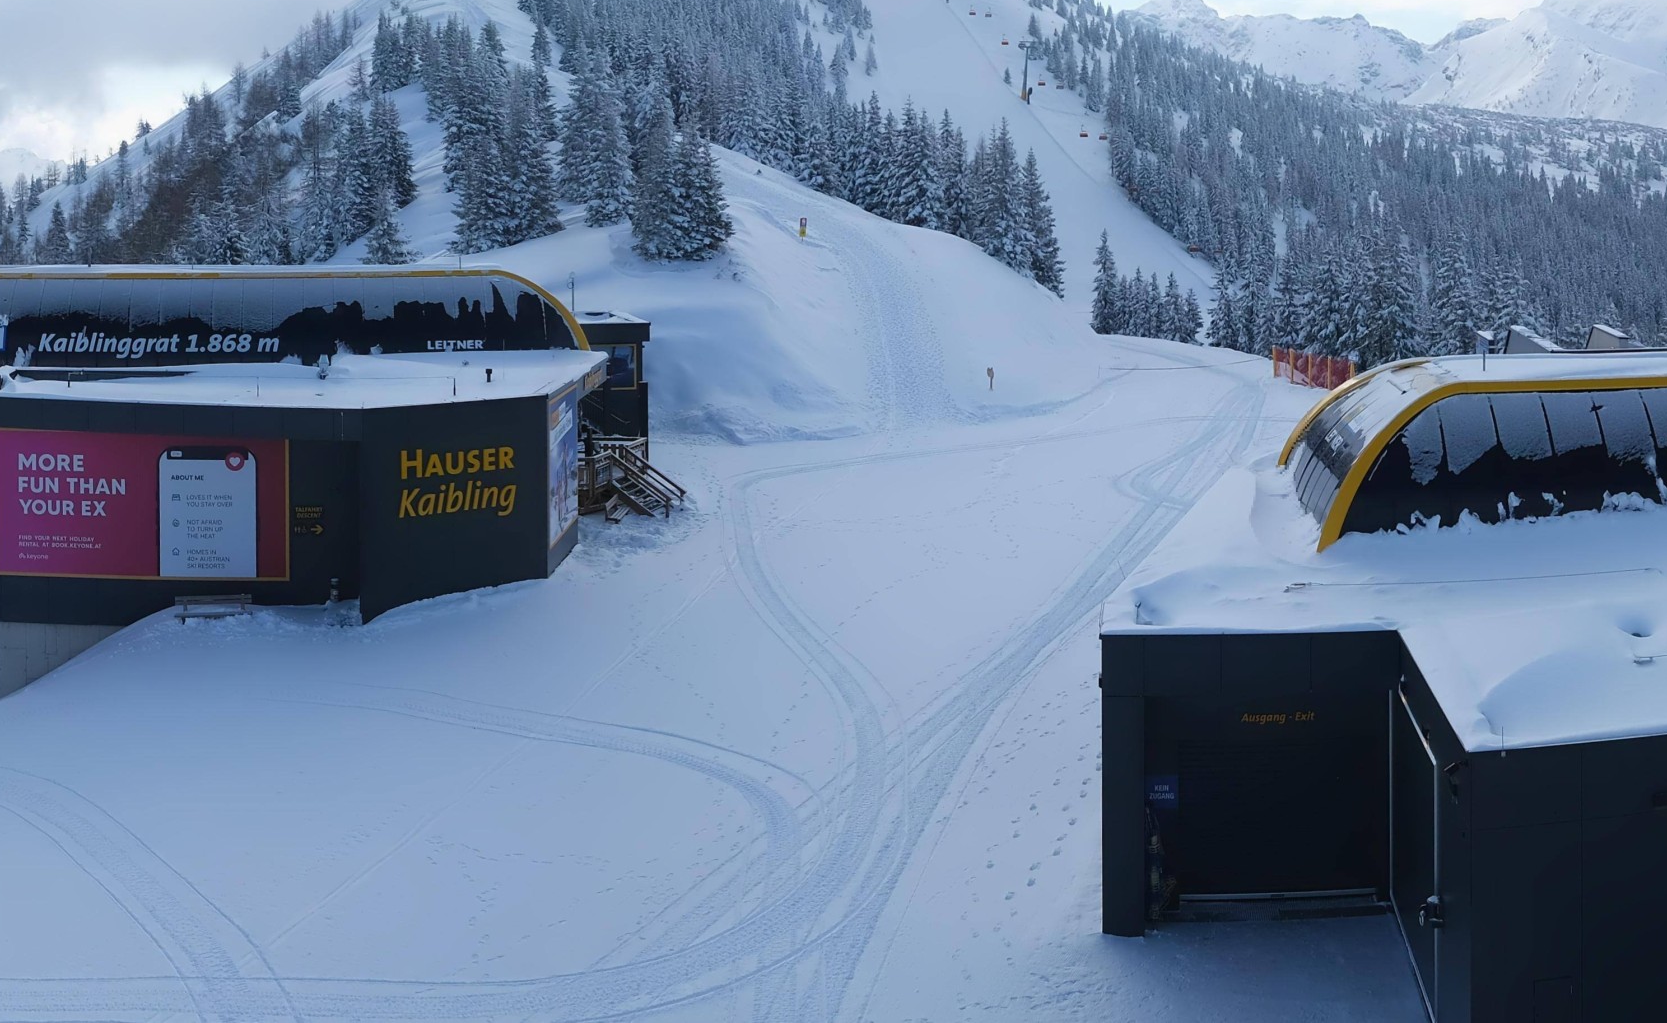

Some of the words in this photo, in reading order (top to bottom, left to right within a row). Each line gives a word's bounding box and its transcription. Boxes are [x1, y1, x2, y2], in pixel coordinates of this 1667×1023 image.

[38, 332, 179, 359] Kaiblinggrat
[185, 334, 252, 353] 1.868
[257, 336, 280, 353] m
[427, 339, 484, 350] LEITNER
[18, 453, 85, 472] MORE
[400, 446, 515, 480] HAUSER
[18, 476, 59, 494] FUN
[66, 477, 126, 495] THAN
[19, 498, 75, 516] YOUR
[81, 500, 107, 517] EX
[399, 480, 517, 519] Kaibling
[51, 542, 102, 550] BOOK.KEYONE.AT
[1241, 712, 1287, 725] Ausgang
[1294, 710, 1316, 722] Exit
[1149, 792, 1175, 800] ZUGANG
[1154, 784, 1170, 792] KEIN
